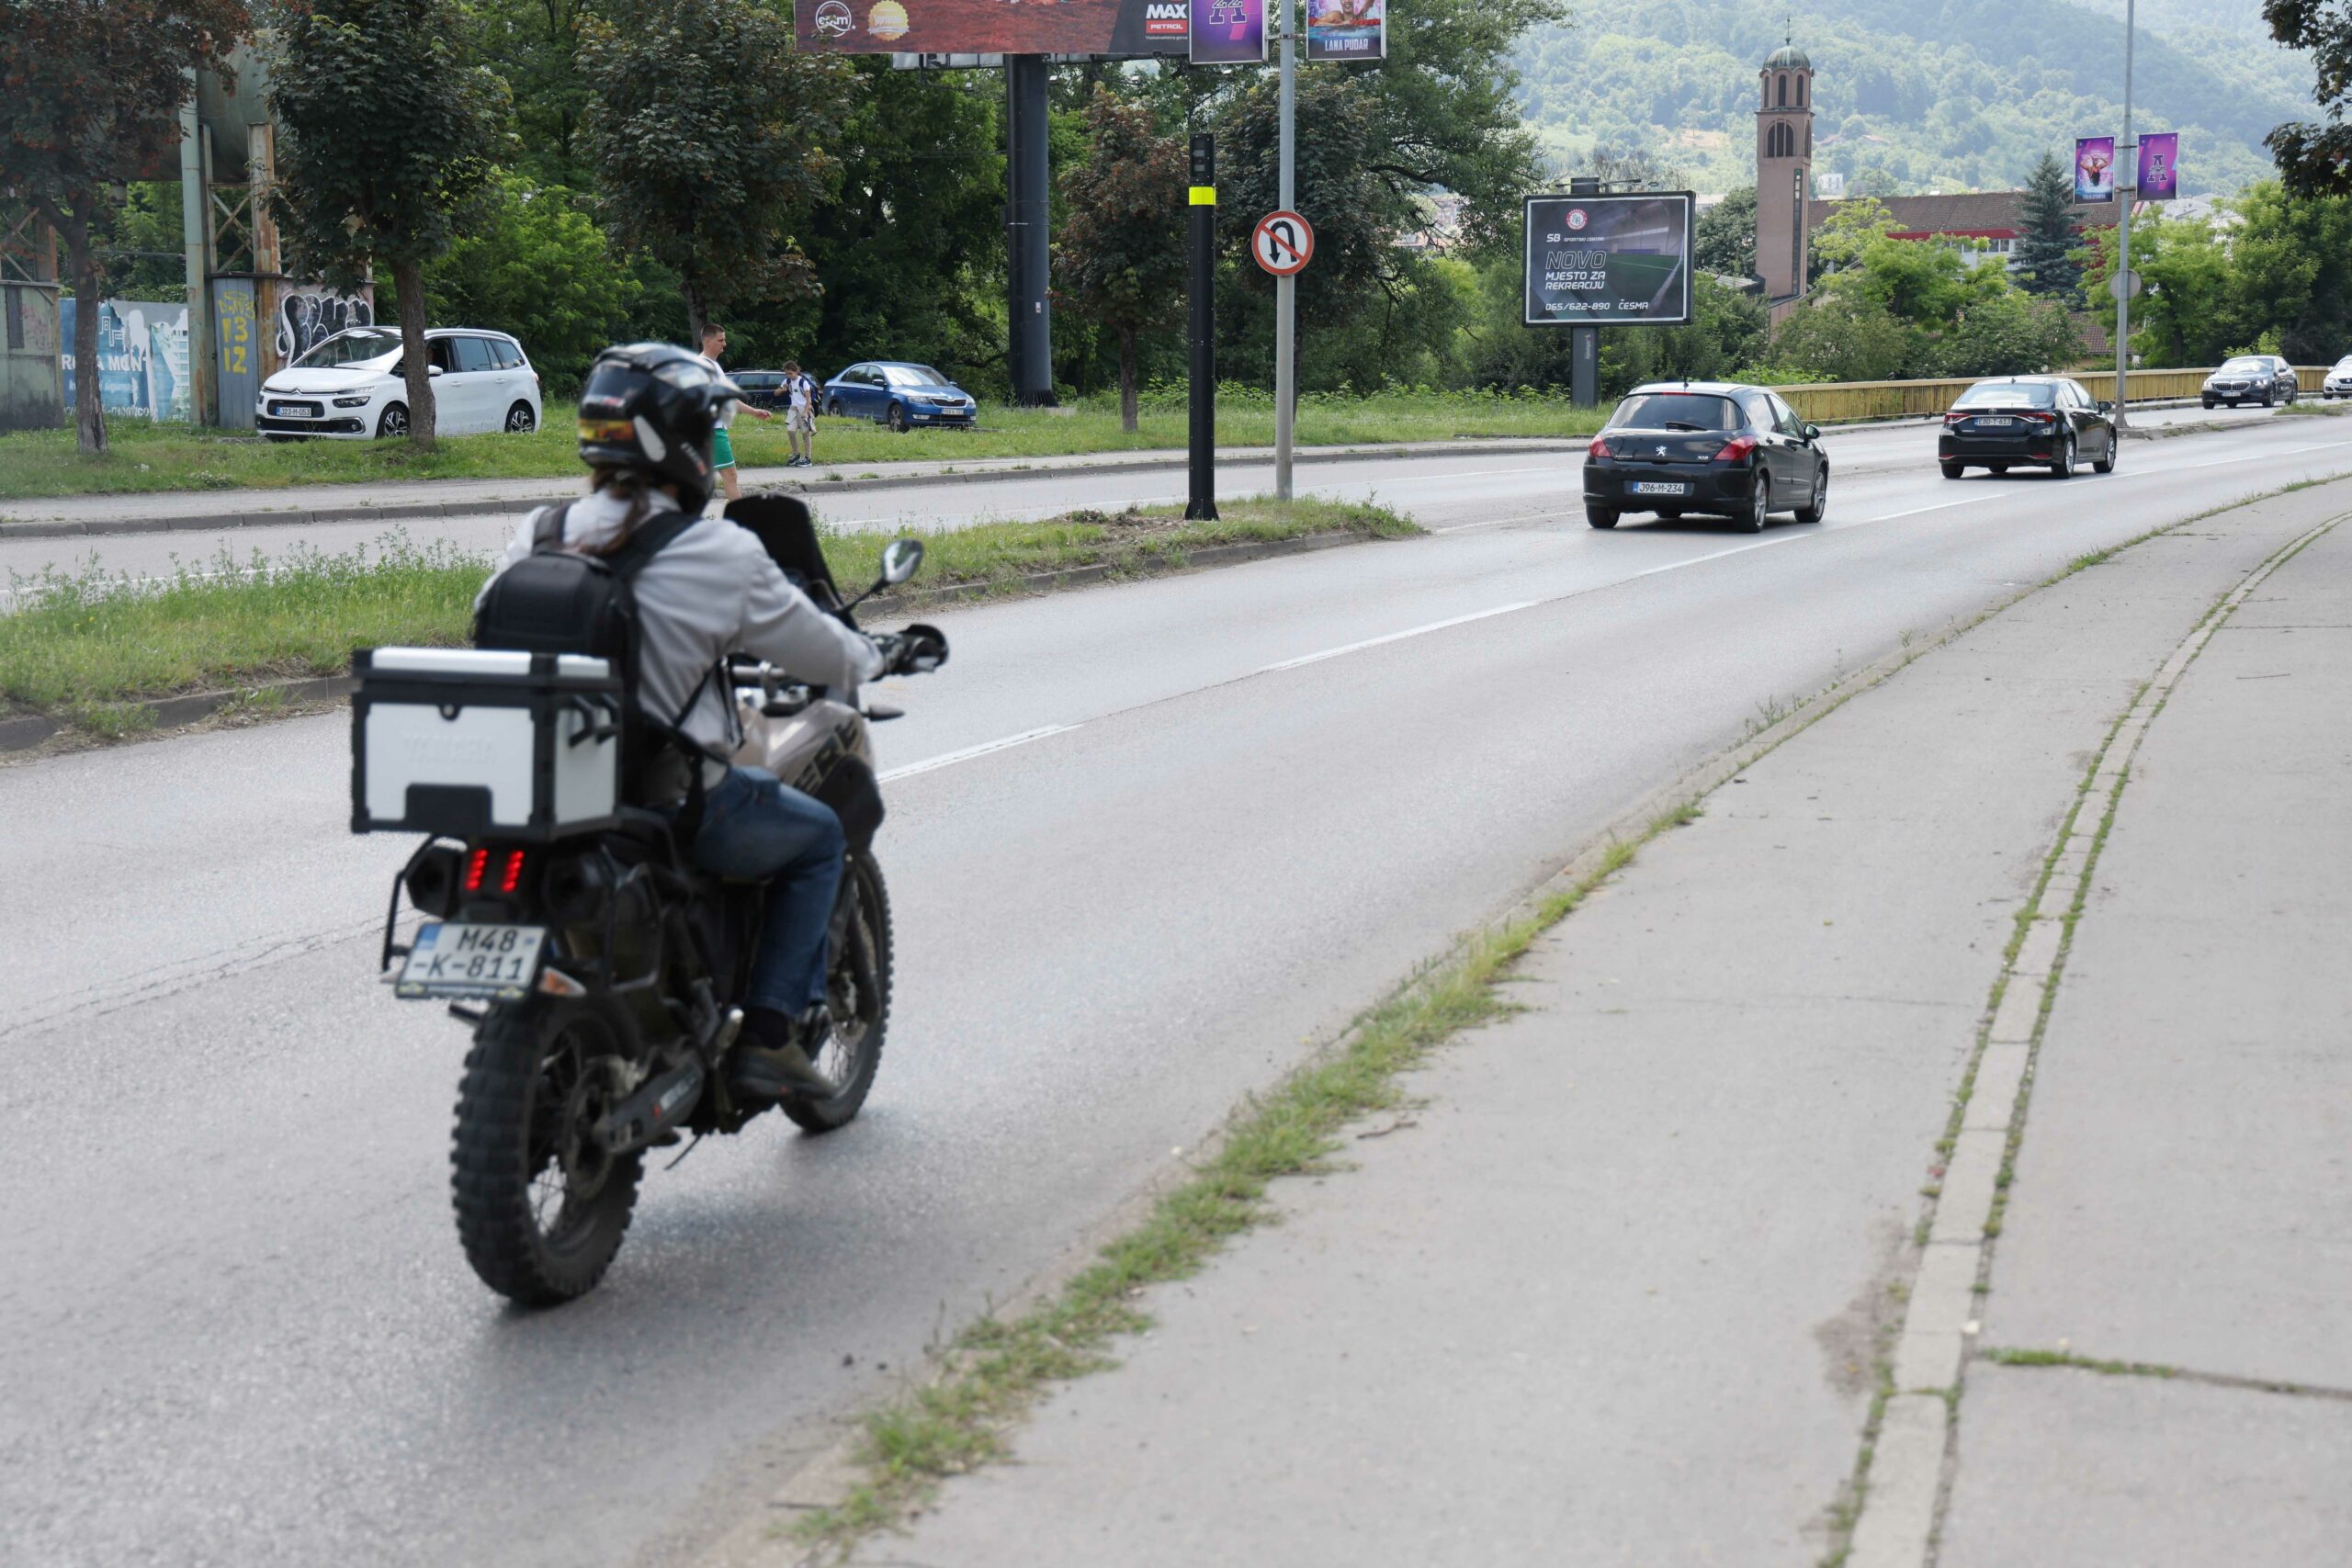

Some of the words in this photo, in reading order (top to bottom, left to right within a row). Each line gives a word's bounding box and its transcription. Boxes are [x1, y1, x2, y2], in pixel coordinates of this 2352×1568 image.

[1146, 4, 1187, 18] MAX
[1325, 39, 1343, 51] LANA
[1546, 233, 1560, 242] SB
[1545, 251, 1607, 269] NOVO
[1545, 272, 1587, 281] MJESTO
[1589, 271, 1605, 280] ZA
[1545, 281, 1604, 290] REKREACIJU
[1545, 302, 1611, 310] 065/622-890
[1618, 299, 1649, 310] ČESMA
[1639, 483, 1682, 493] J96-M-234
[457, 929, 519, 953] M48
